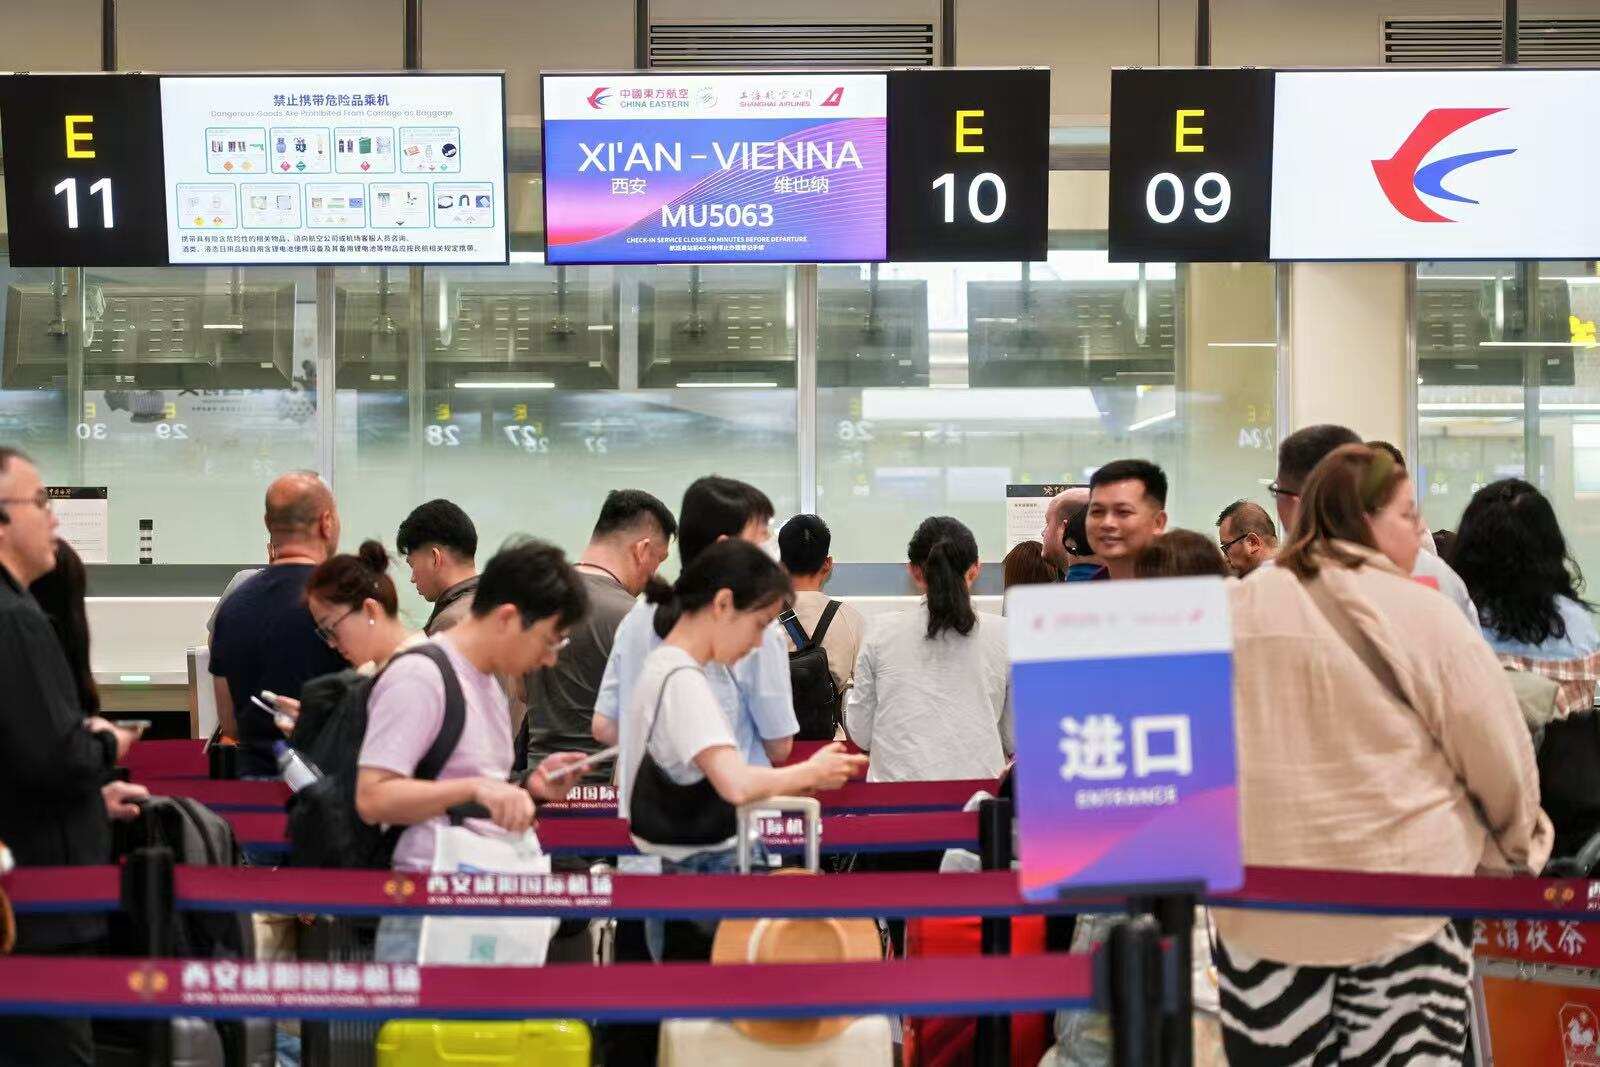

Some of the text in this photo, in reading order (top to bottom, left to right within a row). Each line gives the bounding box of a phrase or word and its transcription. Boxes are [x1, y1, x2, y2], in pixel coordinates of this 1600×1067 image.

[273, 93, 390, 107] 禁止携带危险品乘机
[619, 87, 689, 99] 中國東方航空
[620, 100, 689, 108] CHINA EASTERN
[739, 100, 776, 108] SHANGHAI
[210, 110, 255, 119] Dangerous
[256, 110, 283, 118] Goods
[416, 109, 453, 119] Baggage
[66, 115, 95, 158] E
[956, 110, 984, 152] E
[1176, 110, 1204, 152] E
[578, 142, 682, 172] XI'AN
[712, 141, 863, 171] VIENNA
[611, 178, 646, 194] 西安
[774, 177, 829, 193] 维也纳
[55, 178, 113, 228] 11
[933, 172, 1006, 223] 10
[1146, 172, 1231, 223] 09
[662, 204, 774, 228] MU5063
[626, 236, 656, 244] CHECK-IN
[771, 235, 808, 243] DEPARTURE
[1060, 714, 1193, 781] 进口
[1075, 785, 1178, 809] ENTRANCE
